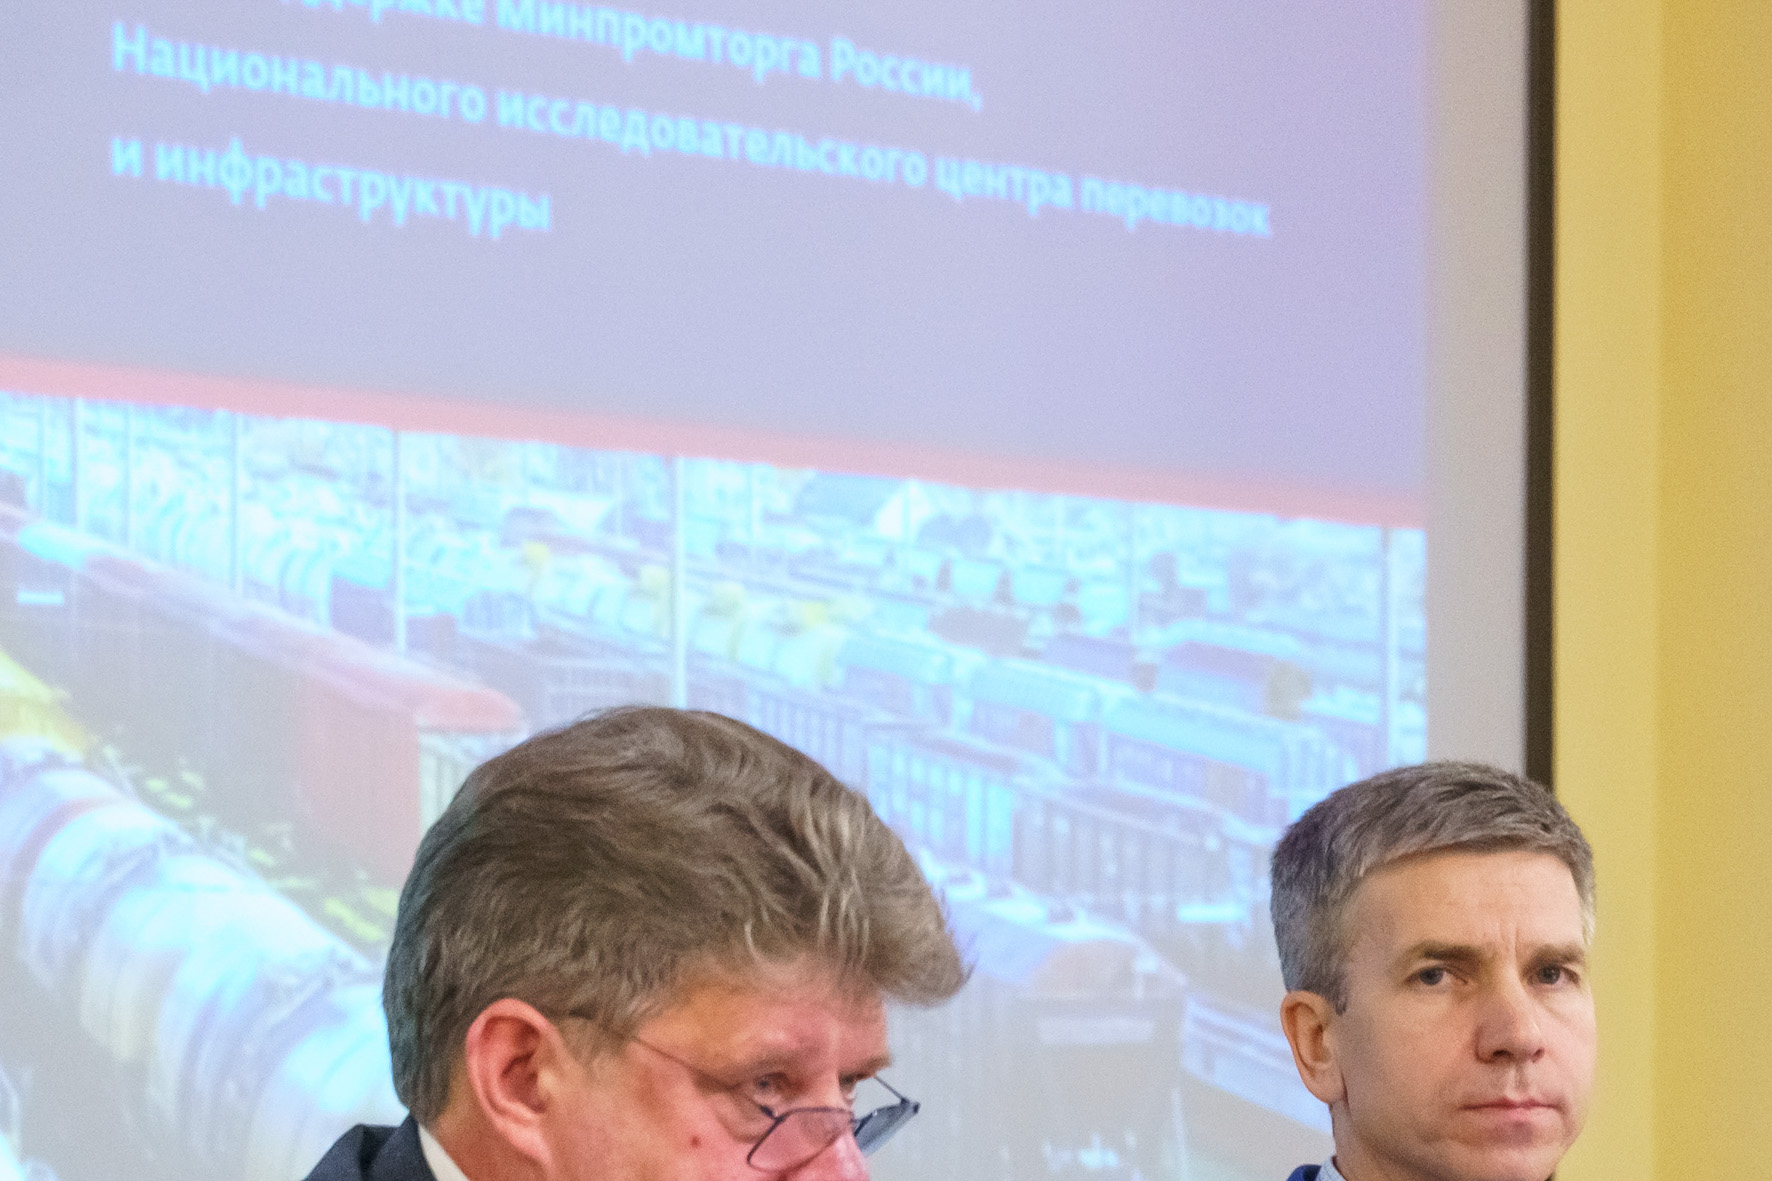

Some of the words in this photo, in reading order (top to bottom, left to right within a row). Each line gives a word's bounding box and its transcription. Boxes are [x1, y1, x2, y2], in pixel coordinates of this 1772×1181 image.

[496, 0, 821, 84] Минпромторга
[830, 35, 983, 112] России,
[112, 20, 487, 124] Национального
[497, 89, 927, 188] исследовательского
[935, 156, 1074, 218] центра
[1080, 175, 1271, 237] перевозок
[111, 136, 143, 178] и
[155, 135, 553, 240] инфраструктуры
